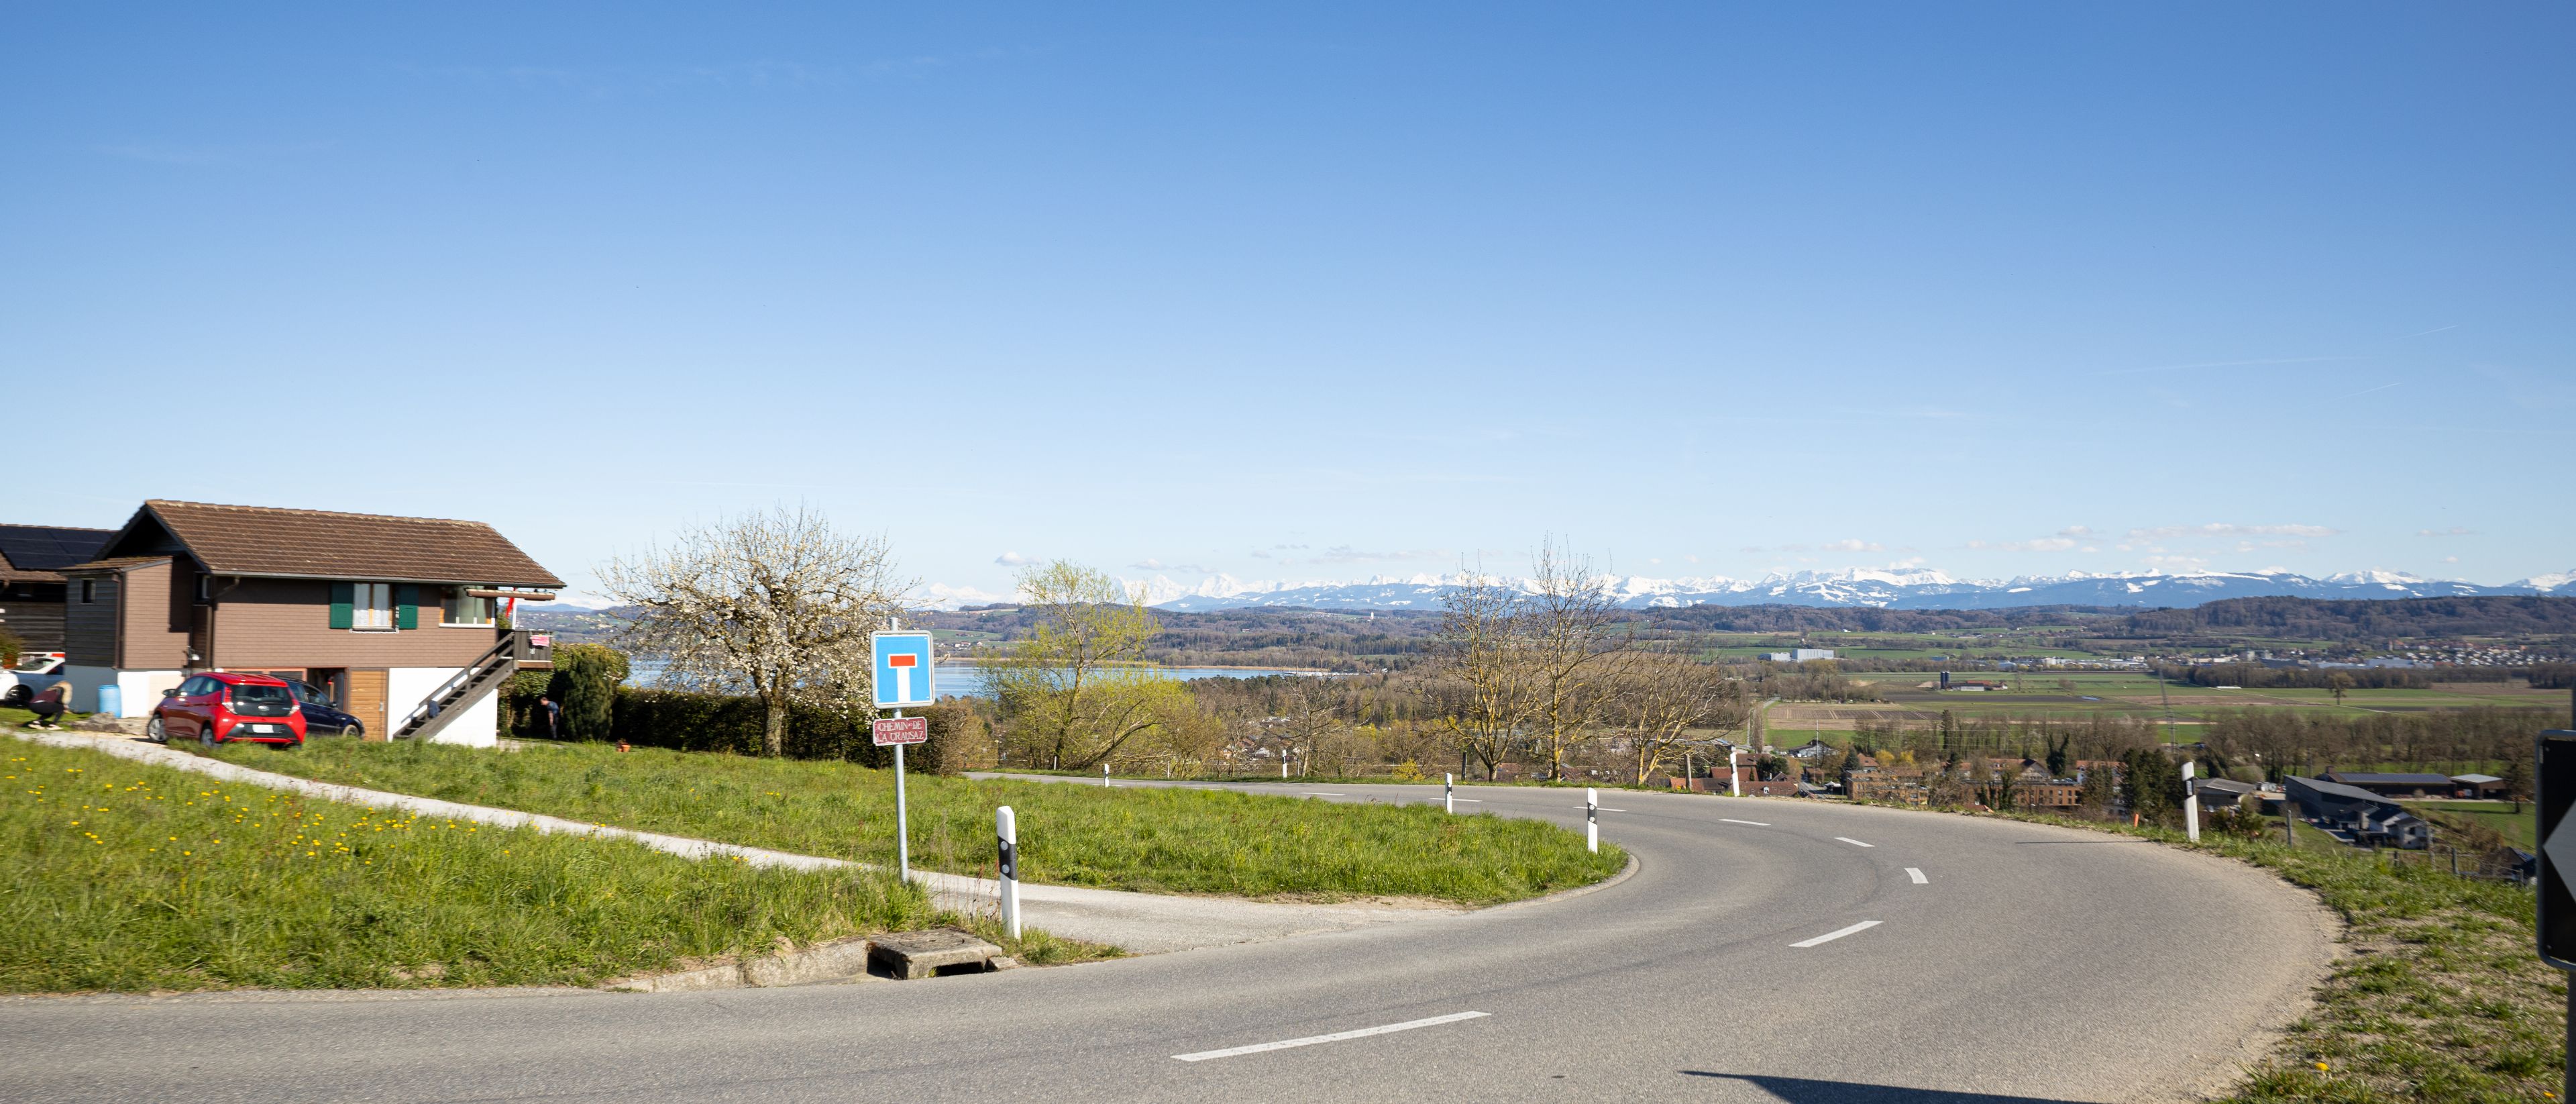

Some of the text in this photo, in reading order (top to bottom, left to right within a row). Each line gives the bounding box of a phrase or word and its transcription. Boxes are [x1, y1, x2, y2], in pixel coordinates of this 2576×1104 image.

[877, 720, 922, 732] CHEMIN DE
[875, 733, 888, 742] LA
